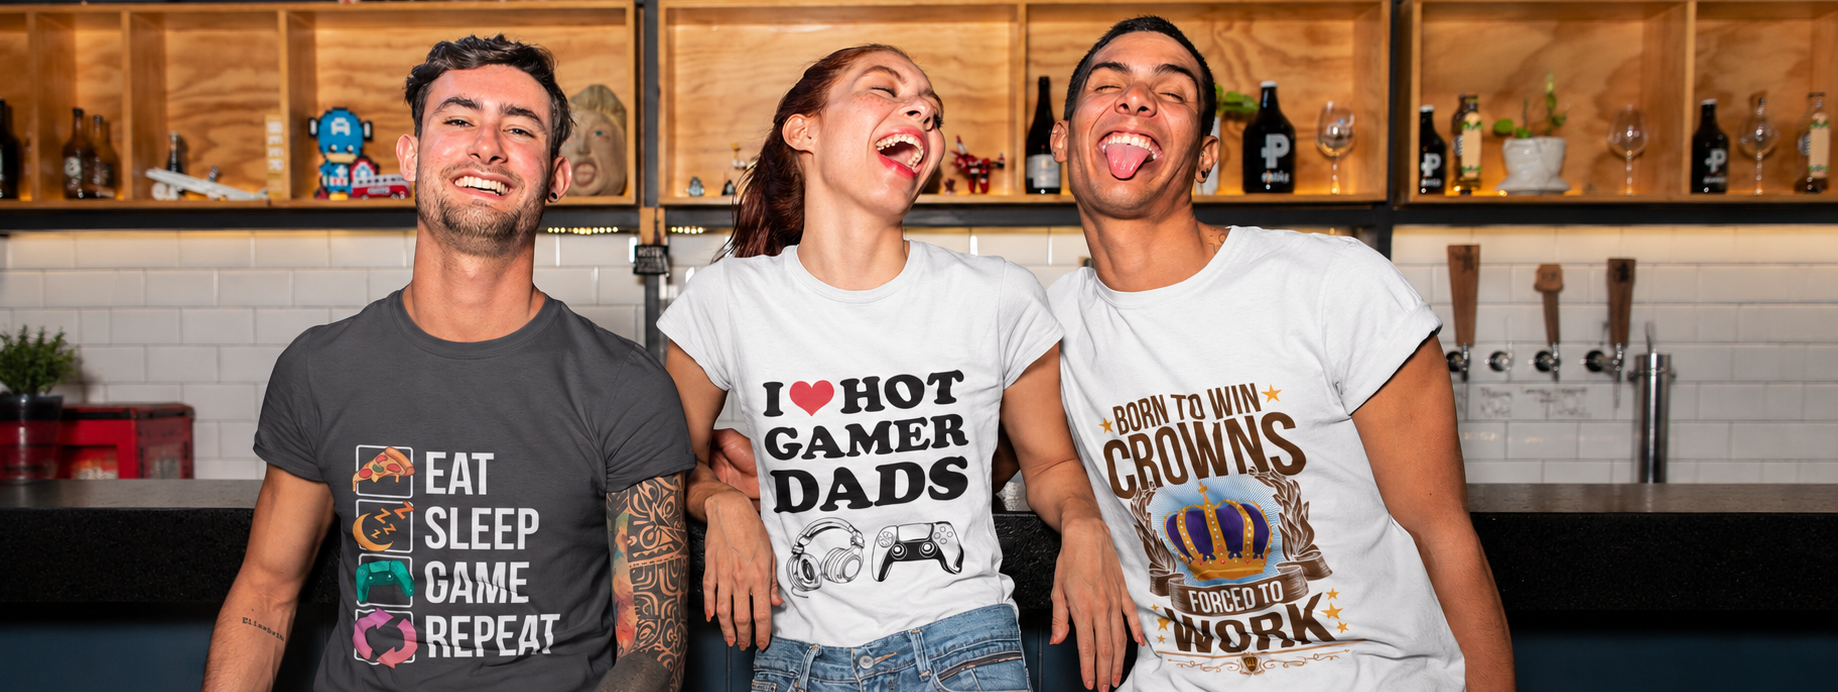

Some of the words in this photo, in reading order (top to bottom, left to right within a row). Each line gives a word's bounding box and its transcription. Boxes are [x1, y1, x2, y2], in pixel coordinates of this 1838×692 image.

[762, 381, 784, 417] I
[839, 369, 965, 414] HOT
[1112, 394, 1170, 435] BORN
[1170, 393, 1206, 421] TO
[1207, 383, 1262, 420] WIN
[764, 413, 970, 461] GAMER
[1103, 411, 1307, 500] CROWNS
[425, 451, 494, 495] EAT
[769, 455, 969, 514] DADS
[424, 506, 540, 550] SLEEP
[424, 560, 530, 604] GAME
[1187, 586, 1257, 614] FORCED
[1257, 580, 1284, 604] TO
[425, 613, 561, 658] REPEAT
[1164, 591, 1338, 654] WORK
